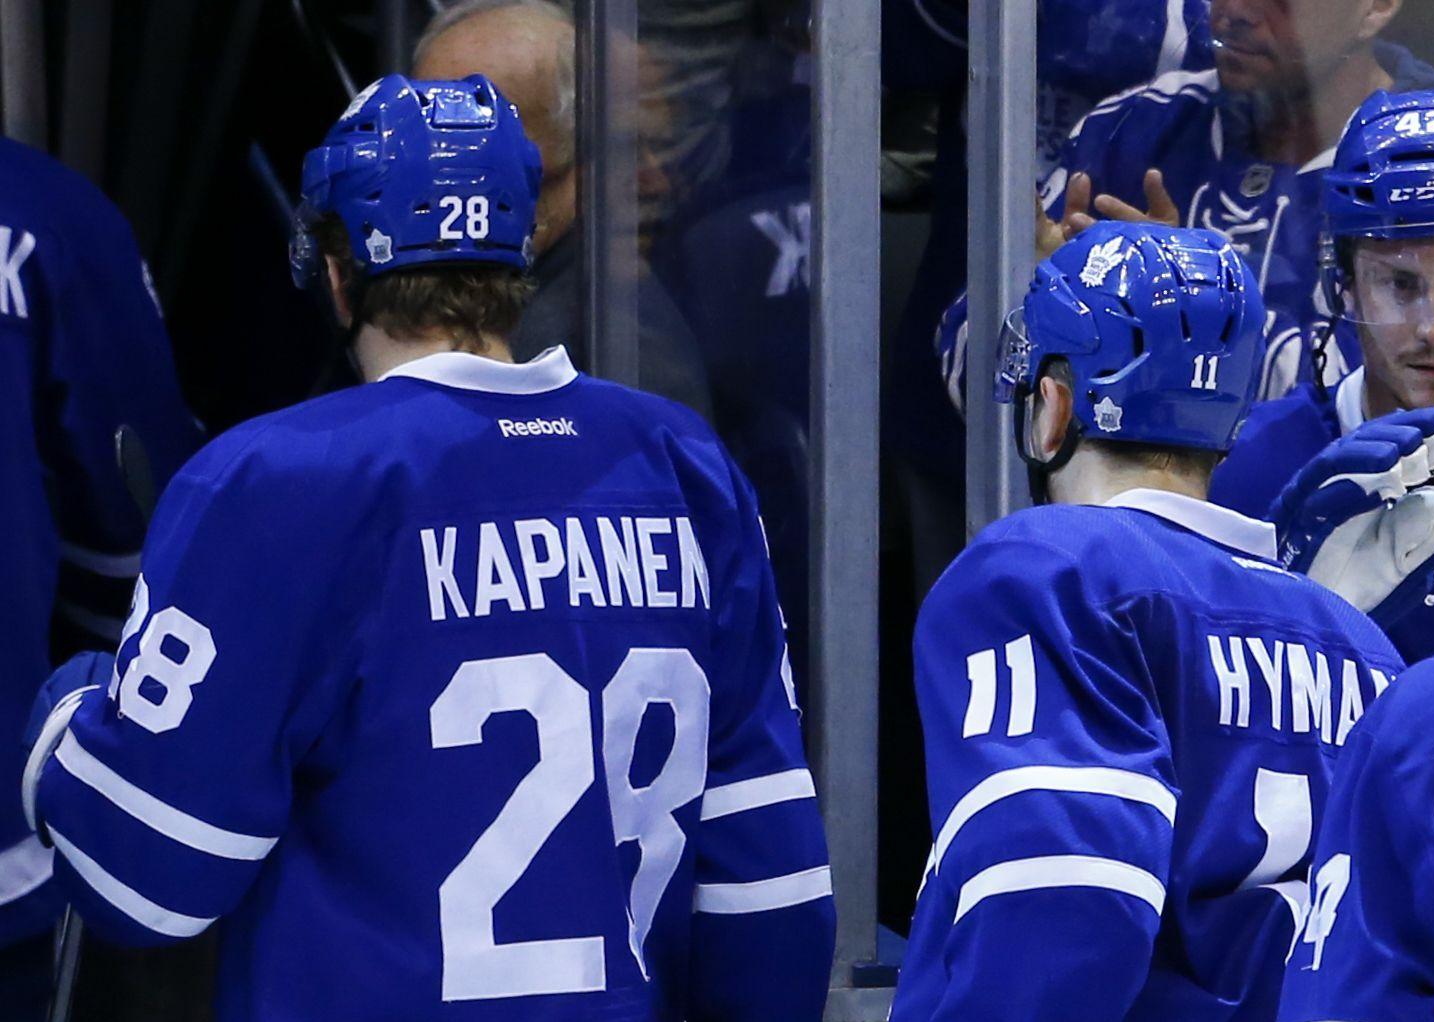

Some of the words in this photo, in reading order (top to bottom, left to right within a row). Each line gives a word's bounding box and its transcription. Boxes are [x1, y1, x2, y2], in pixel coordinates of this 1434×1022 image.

[438, 195, 490, 240] 28
[1190, 354, 1219, 390] 11
[498, 417, 579, 438] Reebok
[419, 516, 711, 622] KAPANEN
[962, 633, 1037, 739] 11
[429, 647, 712, 1002] 28
